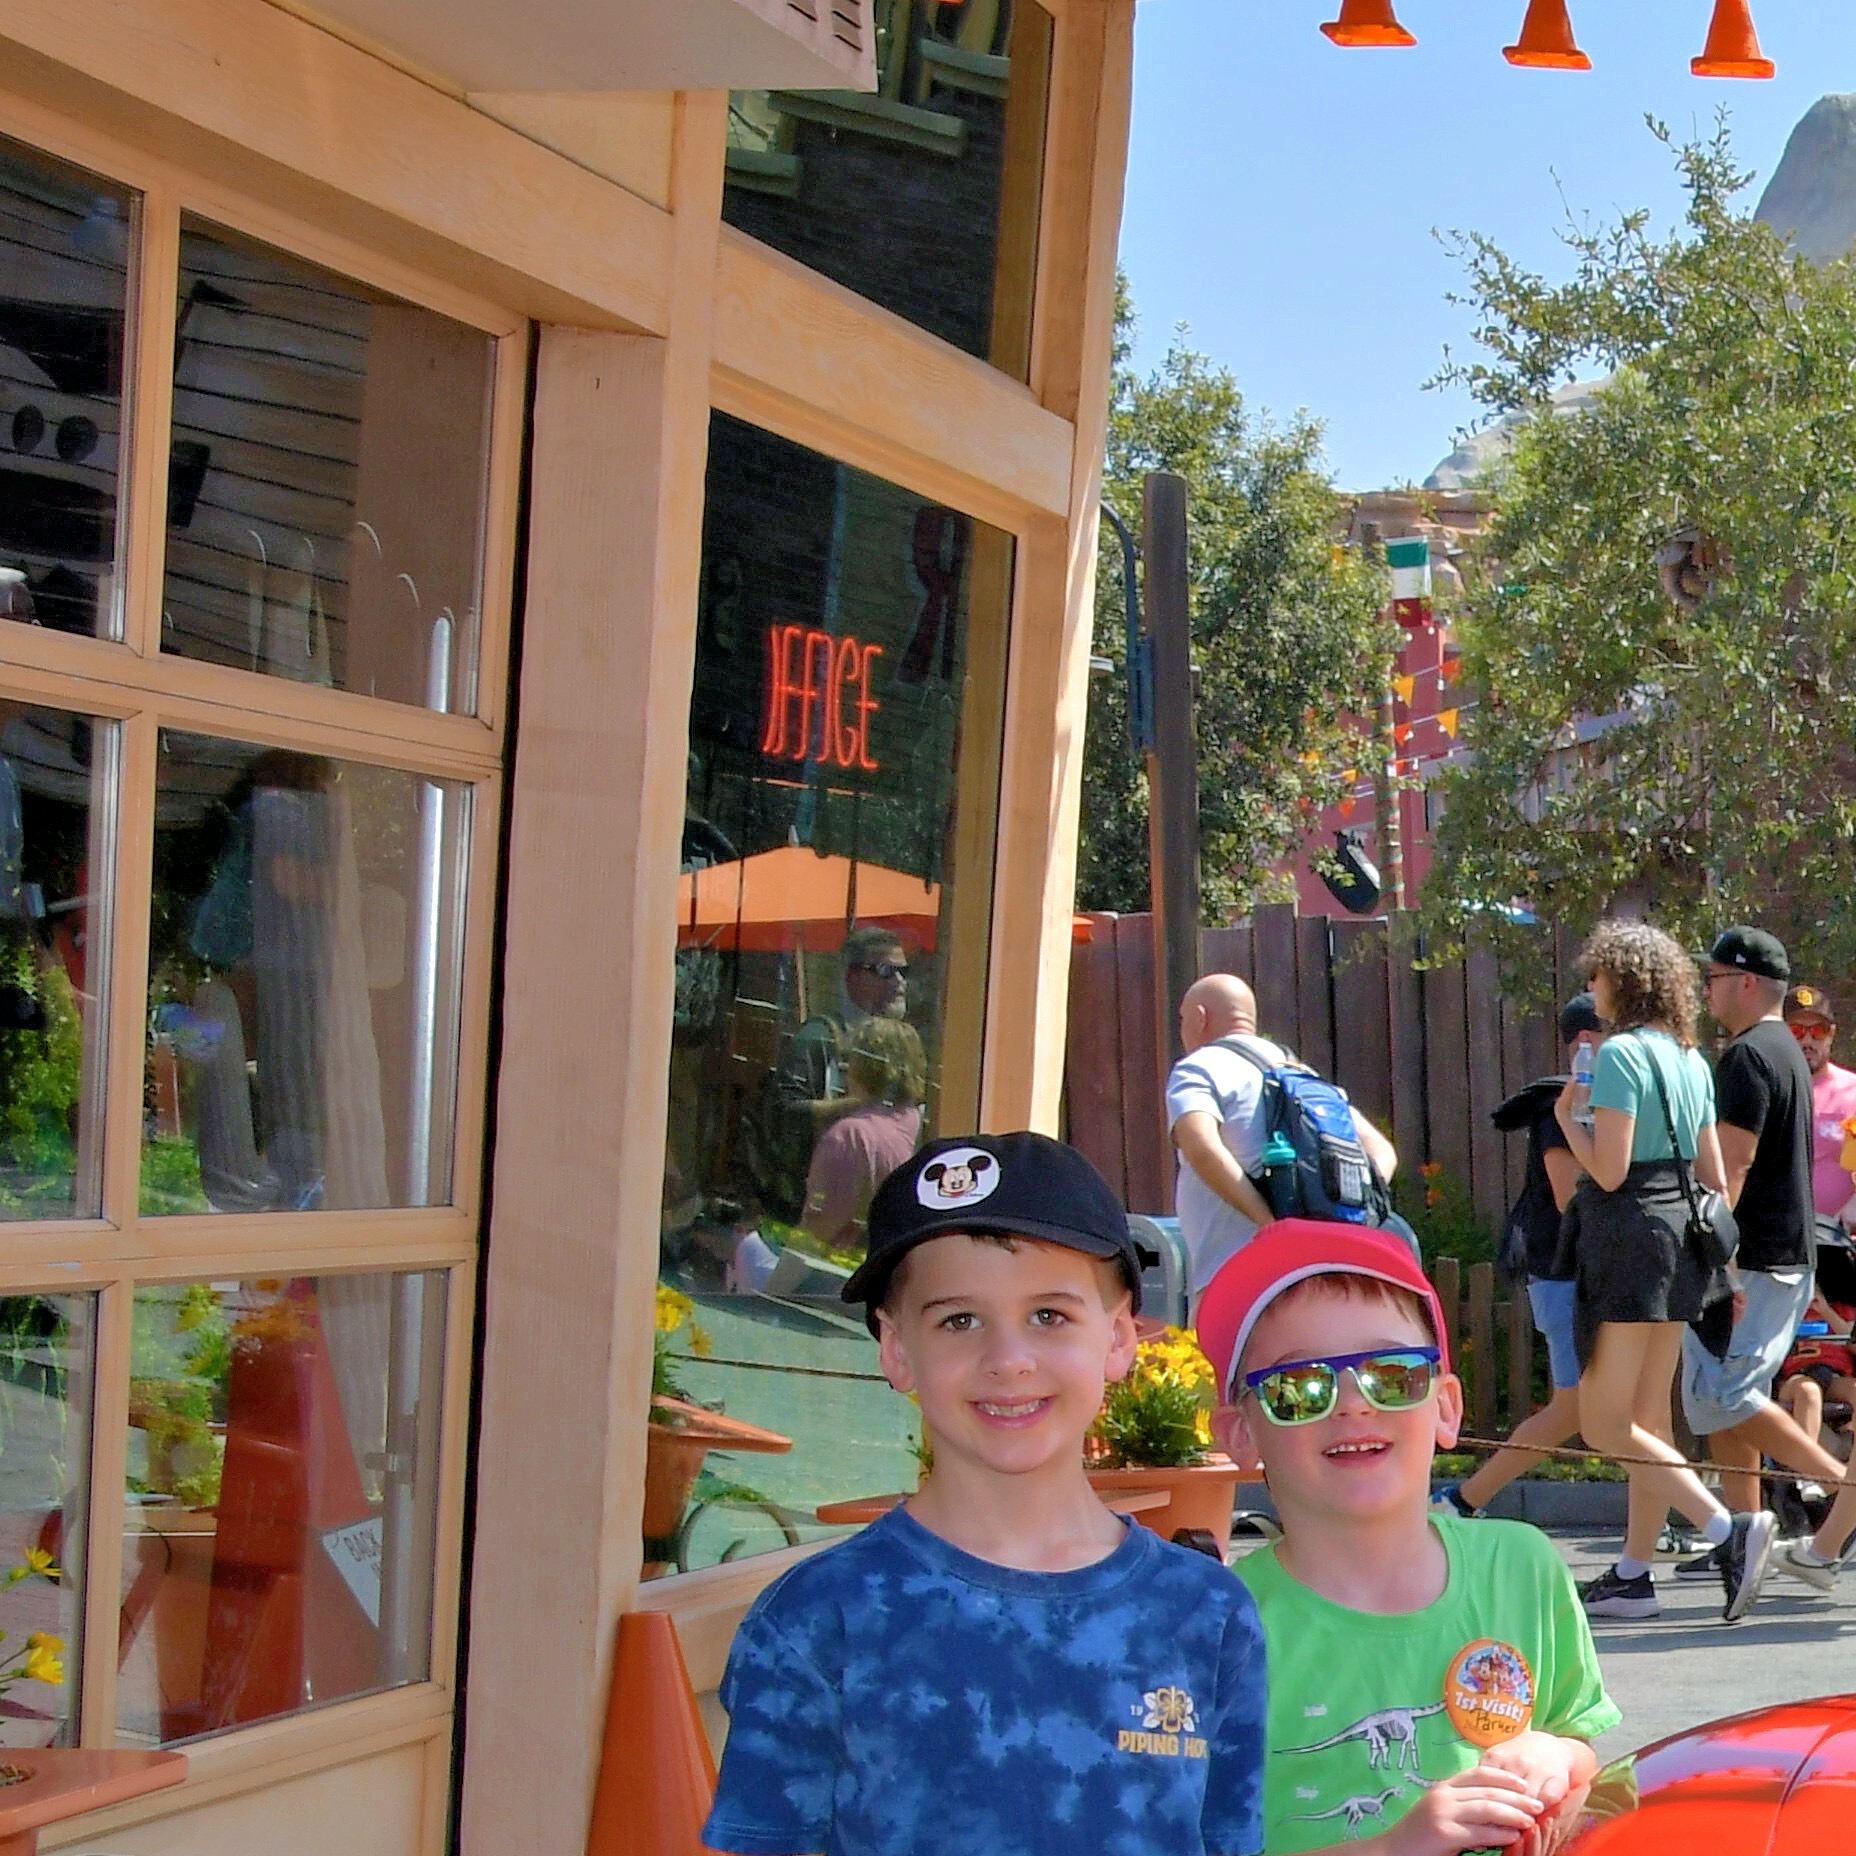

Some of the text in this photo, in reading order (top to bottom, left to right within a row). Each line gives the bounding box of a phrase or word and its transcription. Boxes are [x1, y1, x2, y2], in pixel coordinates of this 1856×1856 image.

[1455, 1691, 1525, 1722] 1st Visit!
[1117, 1729, 1179, 1757] PIPING
